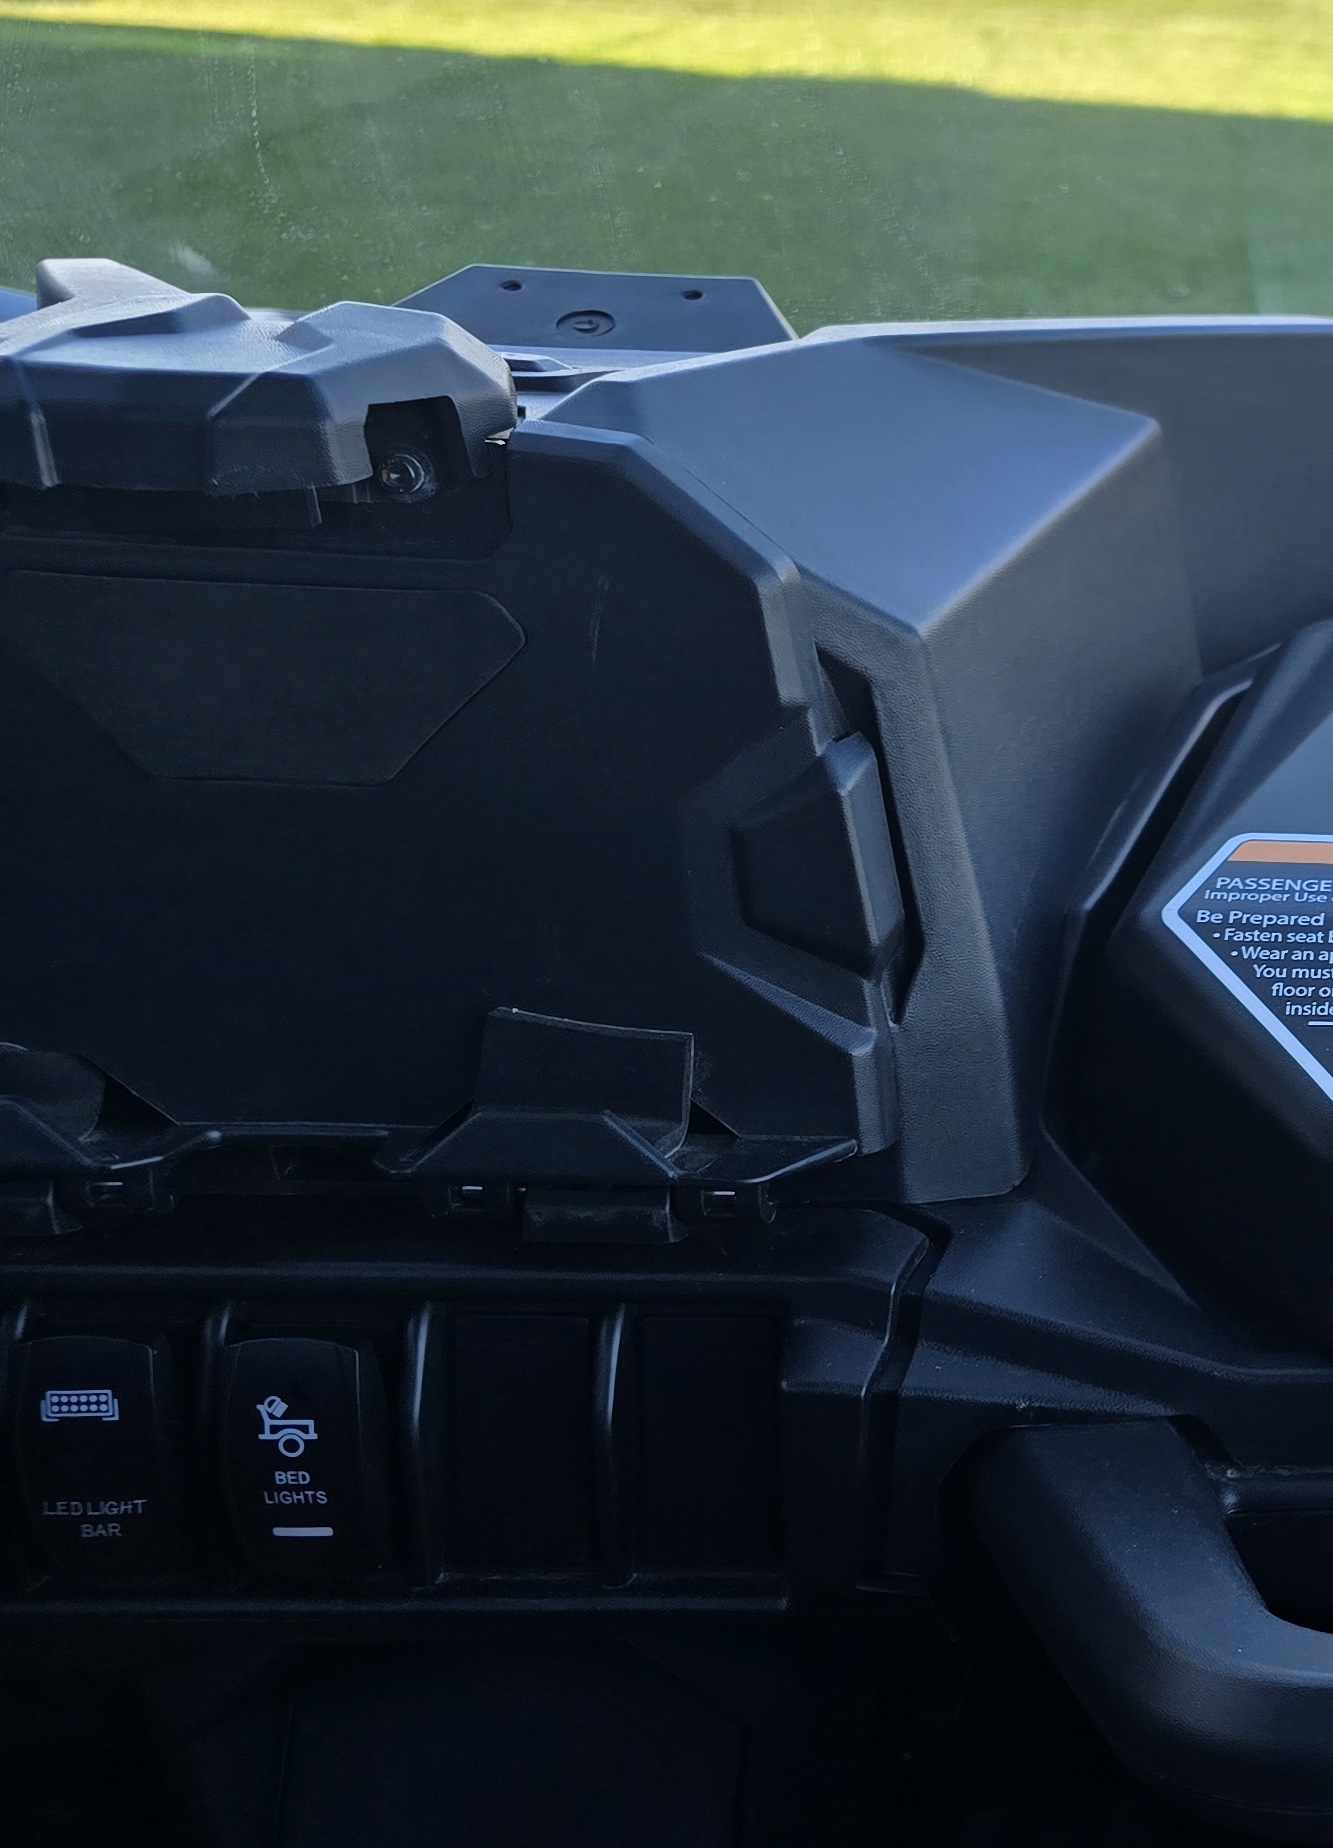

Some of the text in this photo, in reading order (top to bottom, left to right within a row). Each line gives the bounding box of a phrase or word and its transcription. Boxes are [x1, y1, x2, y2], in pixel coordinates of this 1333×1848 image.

[1205, 890, 1290, 903] Improper
[1295, 892, 1327, 902] Use
[1197, 911, 1325, 927] Be Prepared
[1224, 929, 1282, 943] Fasten
[1287, 932, 1324, 943] seat
[1242, 946, 1288, 960] Wear
[1291, 951, 1314, 960] an
[1254, 964, 1287, 978] You
[1272, 982, 1315, 996] floor
[274, 1471, 311, 1485] BED
[263, 1491, 328, 1504] LIGHTS
[43, 1499, 147, 1516] LED LIGHT
[81, 1523, 122, 1537] BAR
